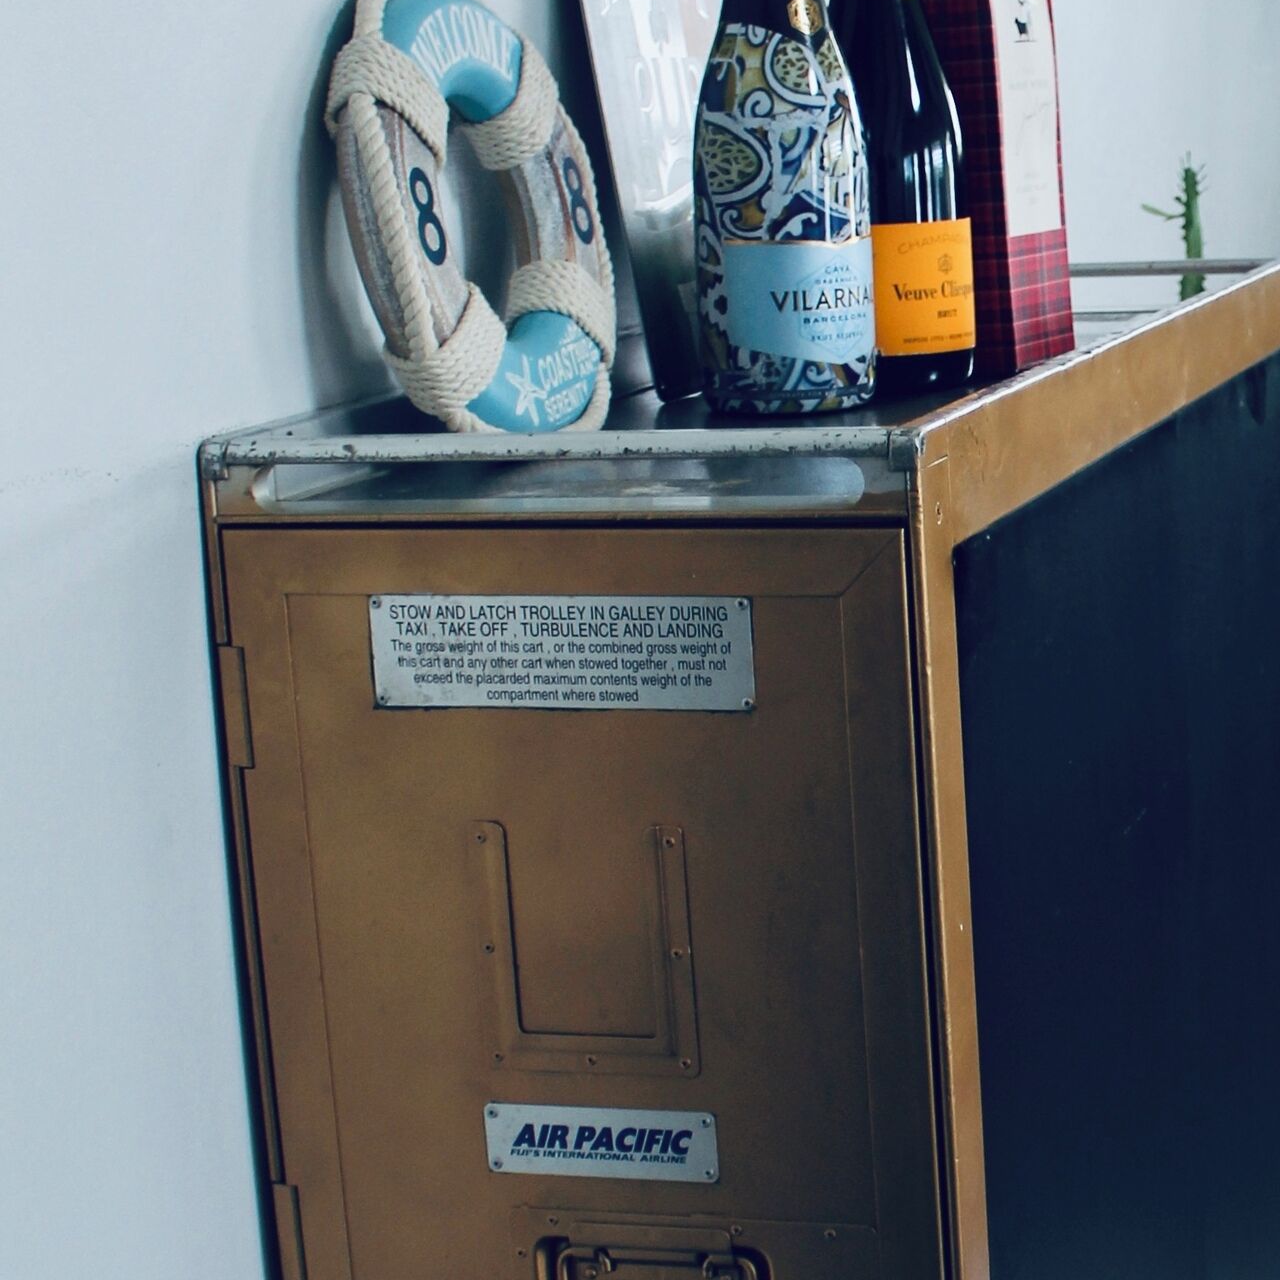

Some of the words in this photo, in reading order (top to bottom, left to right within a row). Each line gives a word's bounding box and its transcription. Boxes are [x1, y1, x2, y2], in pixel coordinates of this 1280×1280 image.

[410, 5, 519, 87] WELCOME
[770, 287, 874, 314] VILARNA
[892, 283, 938, 302] Veuve
[803, 313, 867, 325] BARCELONA
[537, 345, 579, 391] COAST
[389, 604, 432, 620] STOW
[436, 604, 466, 620] AND
[469, 605, 516, 620] LATCH
[520, 605, 586, 621] TROLLEY
[590, 606, 605, 621] IN
[608, 606, 666, 621] GALLEY
[669, 606, 728, 621] DURING
[439, 622, 476, 637] TAKE
[520, 622, 619, 638] TURBULENCE
[623, 623, 653, 638] AND
[658, 623, 724, 639] LANDING
[391, 639, 412, 652] The
[415, 642, 445, 655] gross
[448, 640, 484, 655] weight
[487, 640, 498, 653] of
[500, 640, 519, 653] this
[554, 643, 565, 654] or
[568, 641, 585, 654] the
[588, 641, 643, 654] combined
[646, 644, 677, 657] gross
[680, 641, 719, 657] weight
[720, 641, 732, 655] of
[398, 657, 416, 668] this
[419, 657, 440, 668] cart
[444, 657, 464, 669] and
[468, 659, 486, 671] any
[490, 657, 518, 669] other
[521, 658, 542, 669] cart
[545, 657, 575, 669] when
[578, 658, 618, 670] stowed
[678, 659, 705, 671] must
[708, 659, 727, 671] not
[413, 673, 453, 684] exceed
[456, 673, 473, 685] the
[476, 673, 530, 687] placarded
[533, 673, 587, 686] maximum
[590, 674, 637, 687] contents
[641, 674, 677, 689] weight
[680, 674, 691, 687] of
[694, 674, 712, 687] the
[487, 689, 559, 702] compartment
[562, 689, 596, 702] where
[598, 689, 639, 702] stowed
[512, 1123, 569, 1150] AIR
[573, 1126, 693, 1156] PACIFIC
[510, 1148, 540, 1157] FIJI'S
[543, 1149, 636, 1162] INTERNATIONAL
[639, 1154, 687, 1165] AIRLINE
